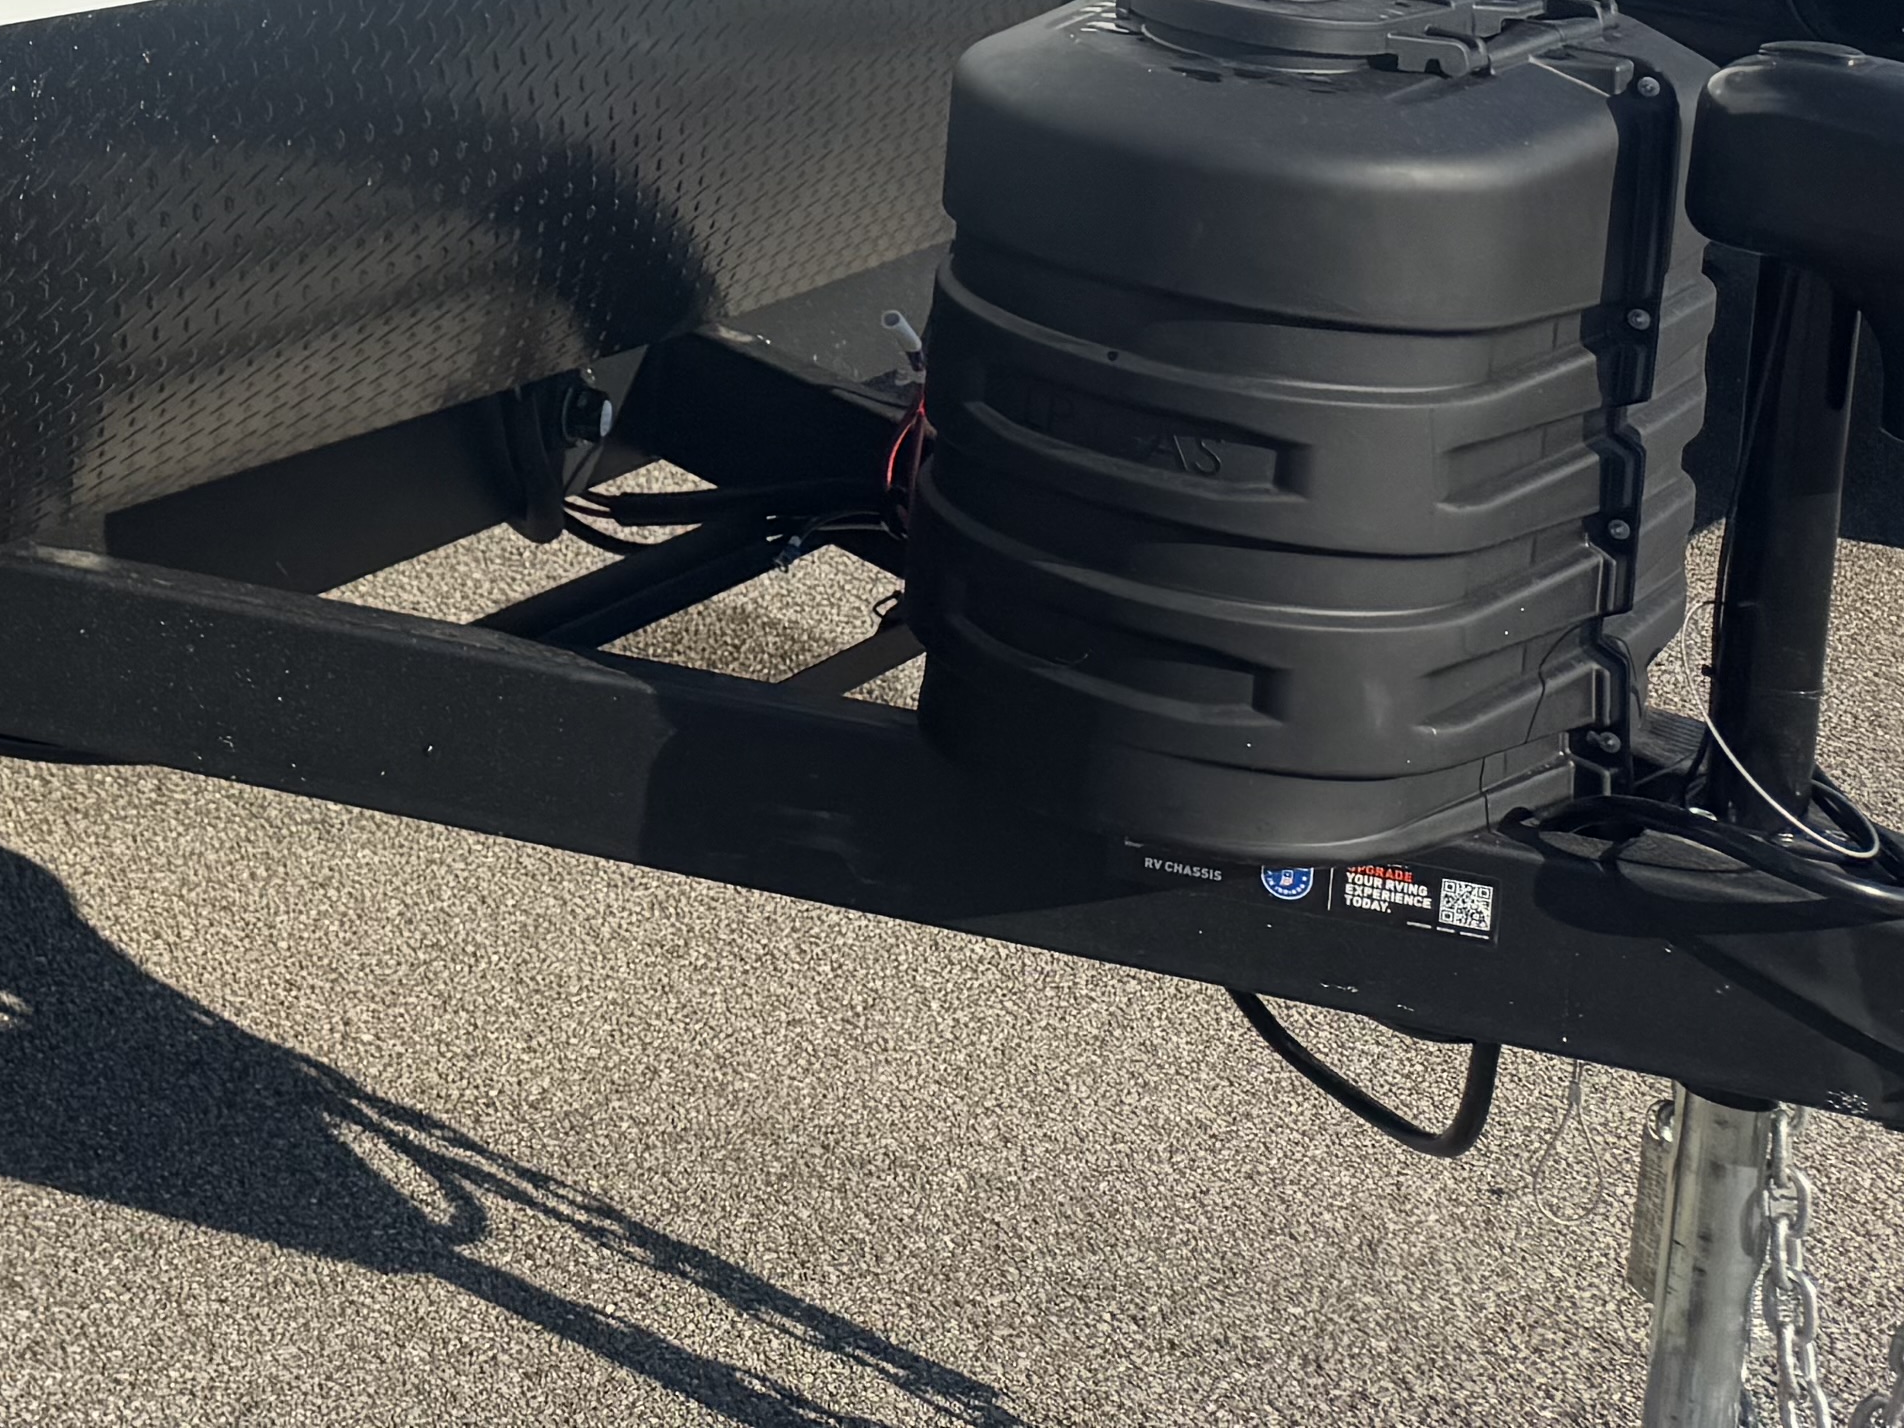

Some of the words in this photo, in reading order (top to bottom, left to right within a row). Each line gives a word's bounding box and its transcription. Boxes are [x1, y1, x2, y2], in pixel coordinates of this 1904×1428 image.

[1144, 857, 1162, 870] RV
[1164, 861, 1223, 881] CHASSIS
[1344, 883, 1433, 910] EXPERIENCE
[1345, 872, 1383, 889] YOUR
[1385, 879, 1429, 897] RVING
[1343, 894, 1392, 914] TODAY.
